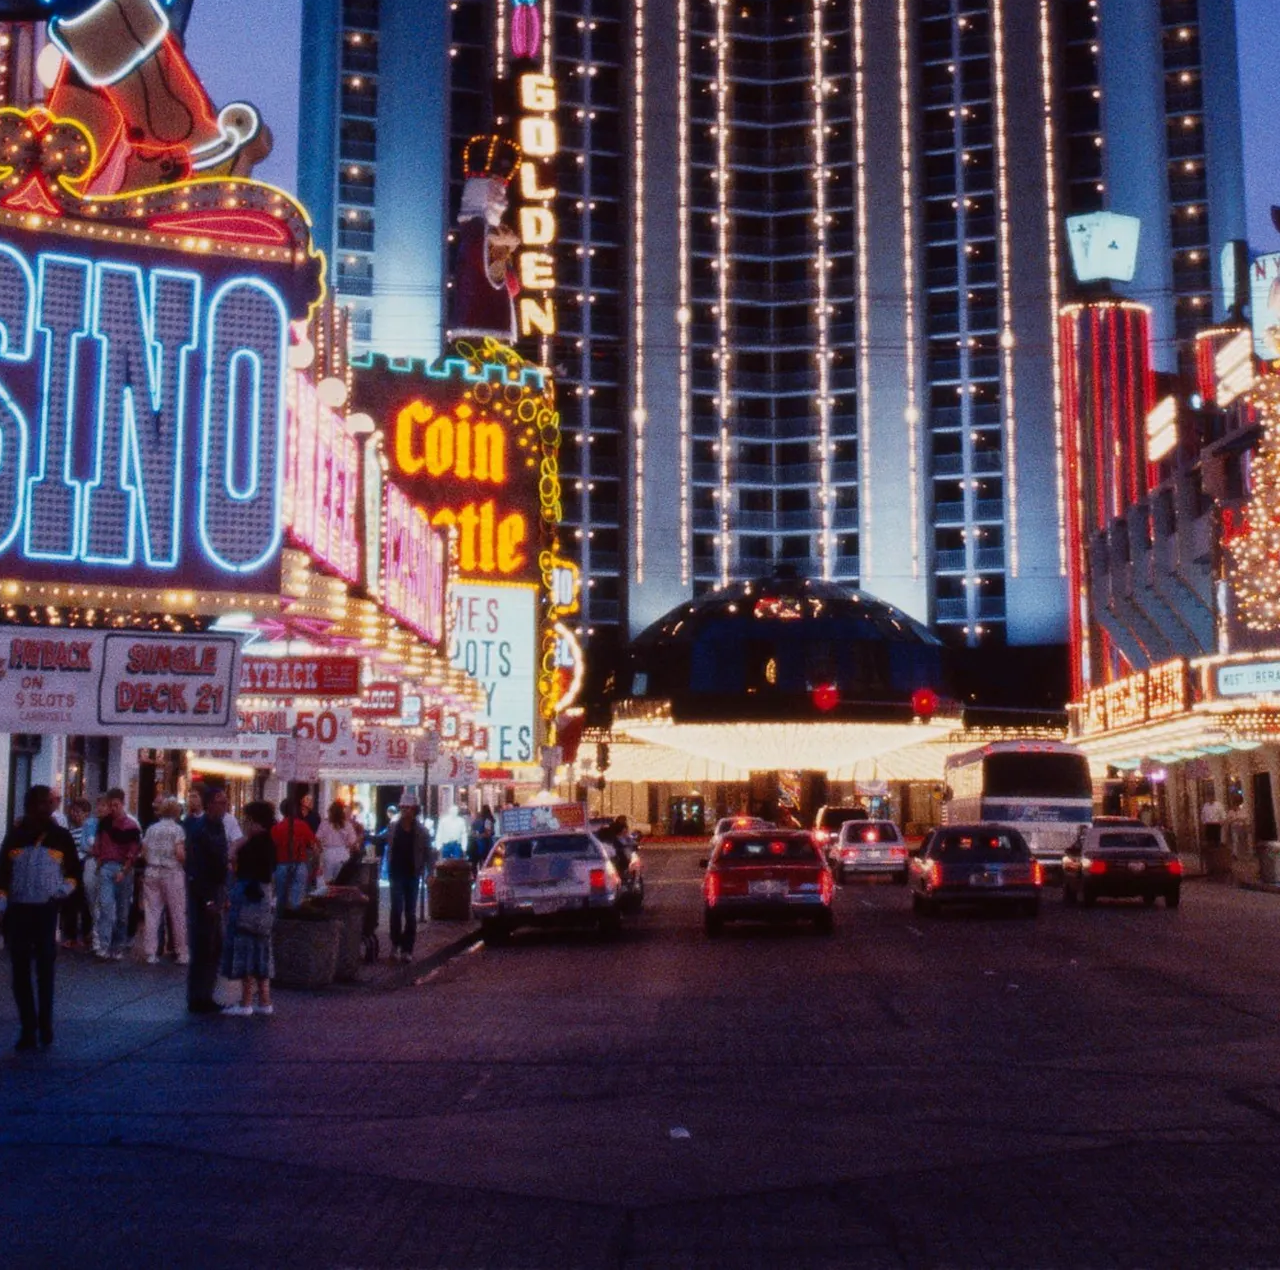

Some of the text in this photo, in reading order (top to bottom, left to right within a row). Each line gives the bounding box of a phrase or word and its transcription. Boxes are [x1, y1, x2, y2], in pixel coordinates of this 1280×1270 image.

[520, 72, 558, 336] GOLDEN
[395, 399, 505, 483] Coin
[127, 642, 218, 675] SINGLE
[115, 680, 224, 715] DECK 21
